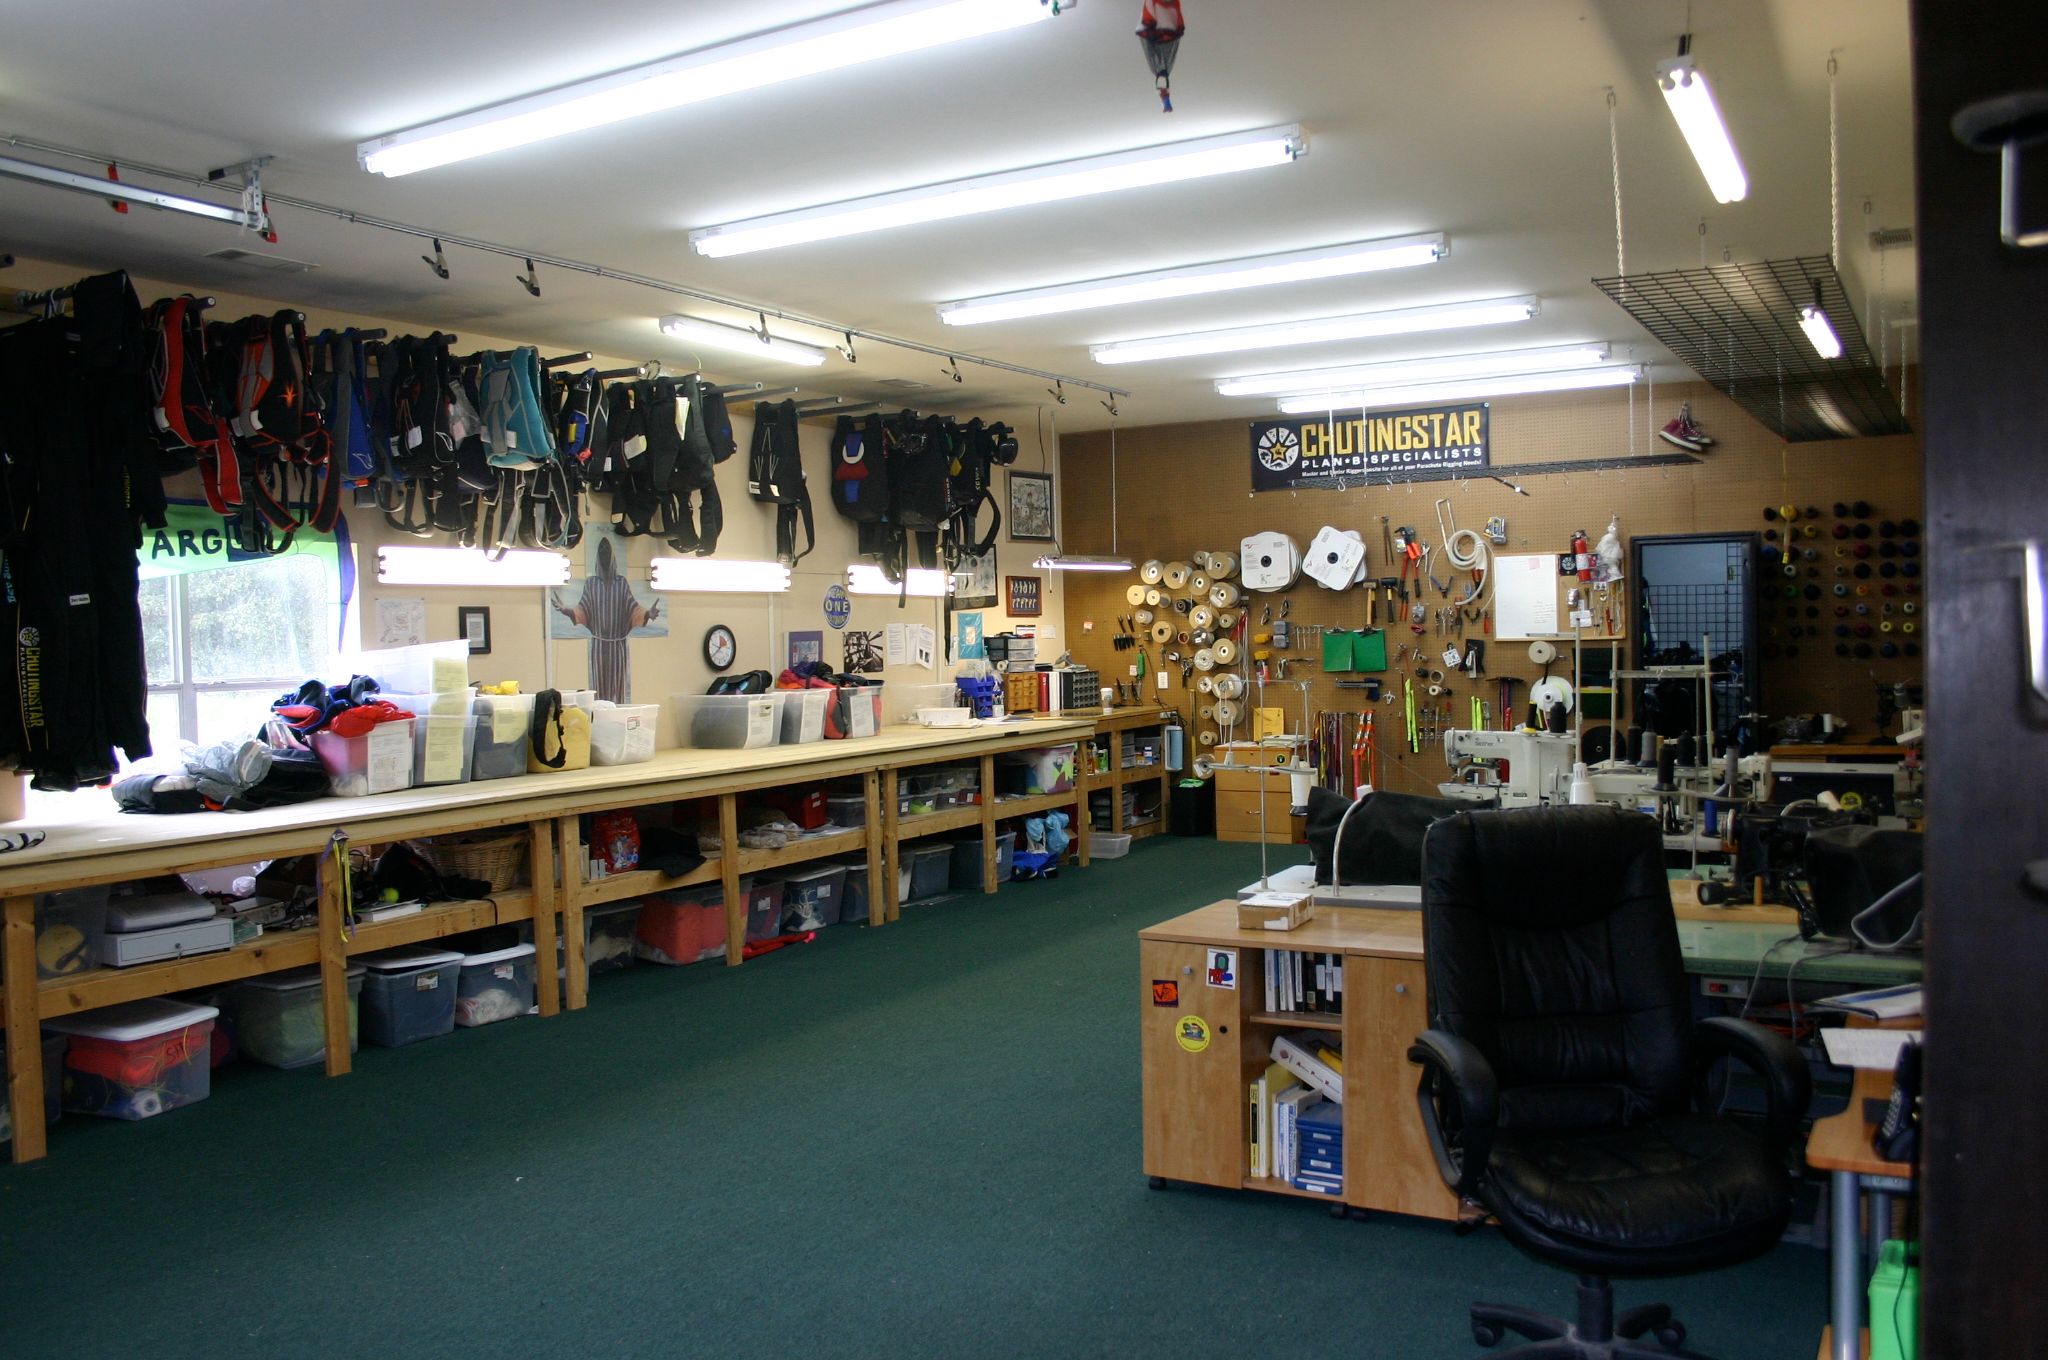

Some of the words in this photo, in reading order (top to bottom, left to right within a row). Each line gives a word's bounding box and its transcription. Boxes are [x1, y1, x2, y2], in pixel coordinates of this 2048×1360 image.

[1300, 411, 1481, 457] CHUTINGSTAR
[1301, 456, 1343, 469] PLAN
[1352, 456, 1361, 465] B
[1370, 447, 1482, 464] SPECIALISTS
[825, 600, 849, 613] ONE
[25, 647, 46, 728] CHUTINGSTAR
